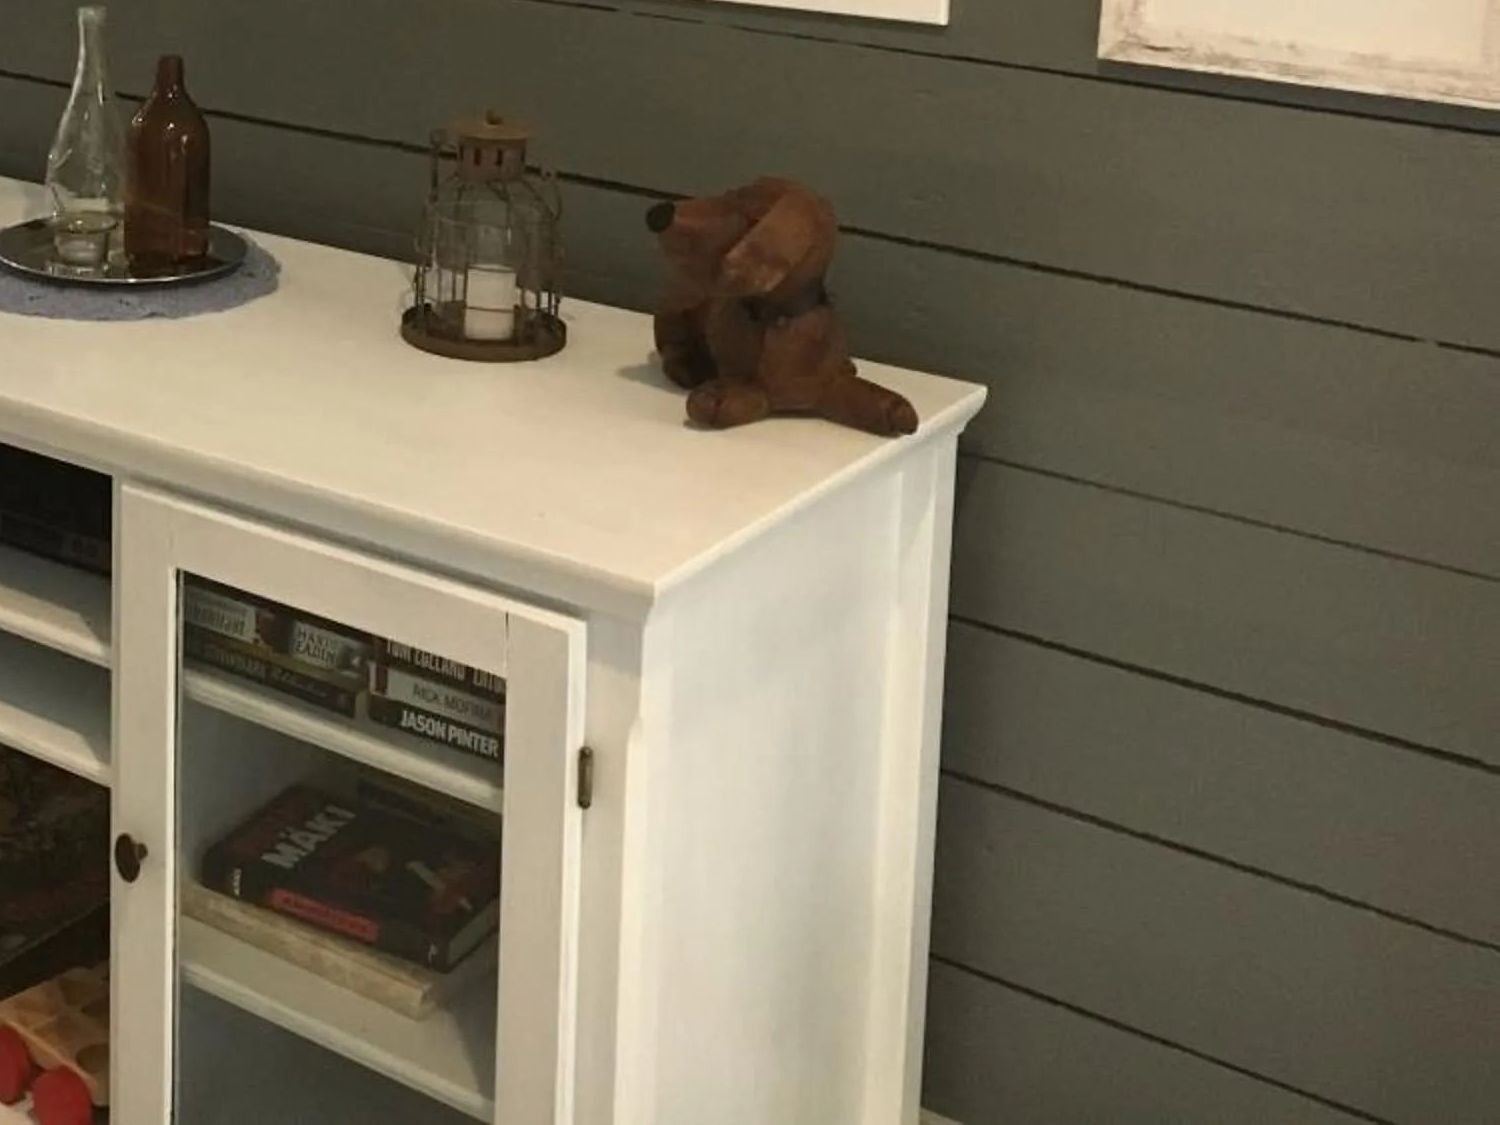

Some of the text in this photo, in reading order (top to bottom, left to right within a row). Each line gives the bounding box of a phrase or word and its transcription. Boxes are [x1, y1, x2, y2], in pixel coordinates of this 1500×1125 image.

[400, 710, 499, 757] JASON PINTER
[261, 804, 356, 869] MÄKI
